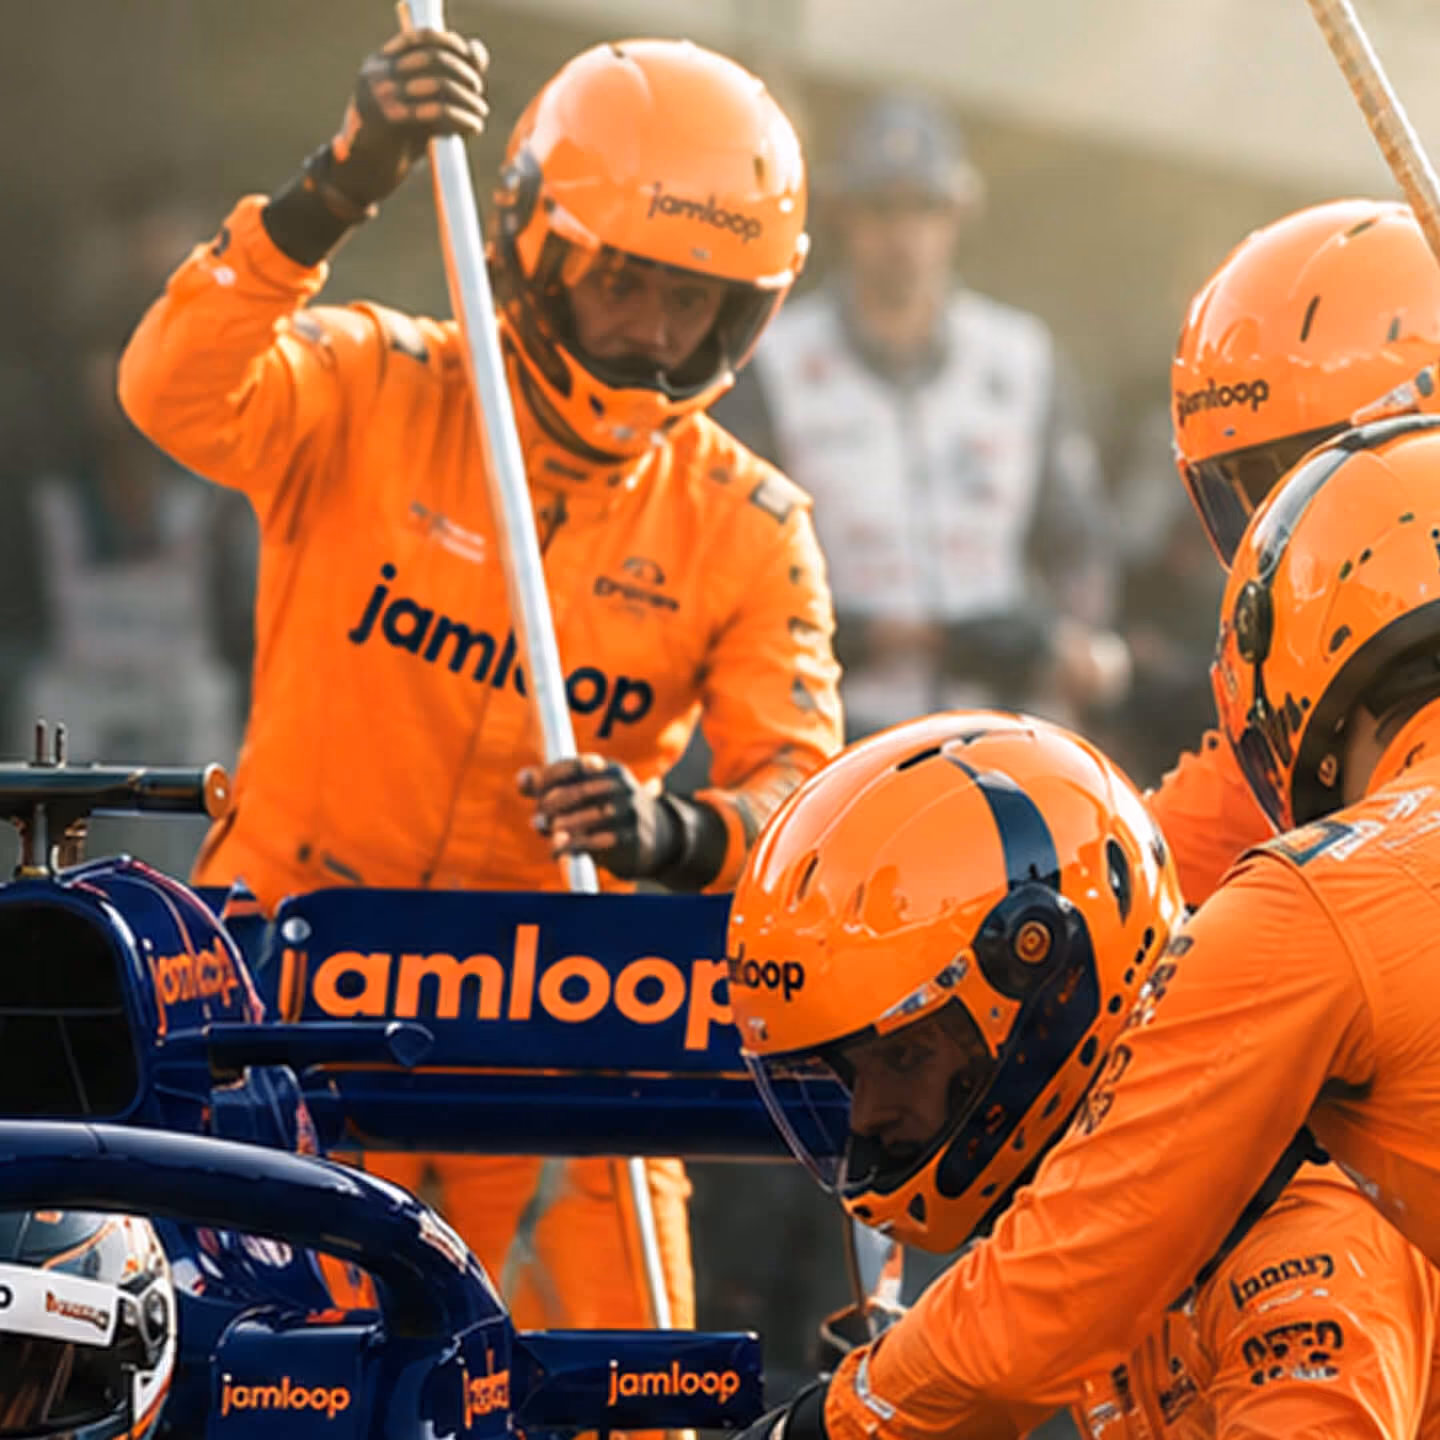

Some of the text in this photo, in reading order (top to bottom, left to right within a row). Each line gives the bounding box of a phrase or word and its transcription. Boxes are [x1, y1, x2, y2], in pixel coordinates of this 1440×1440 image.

[347, 562, 654, 739] jamlop
[221, 1373, 351, 1420] jamloop
[608, 1359, 741, 1406] jamloop
